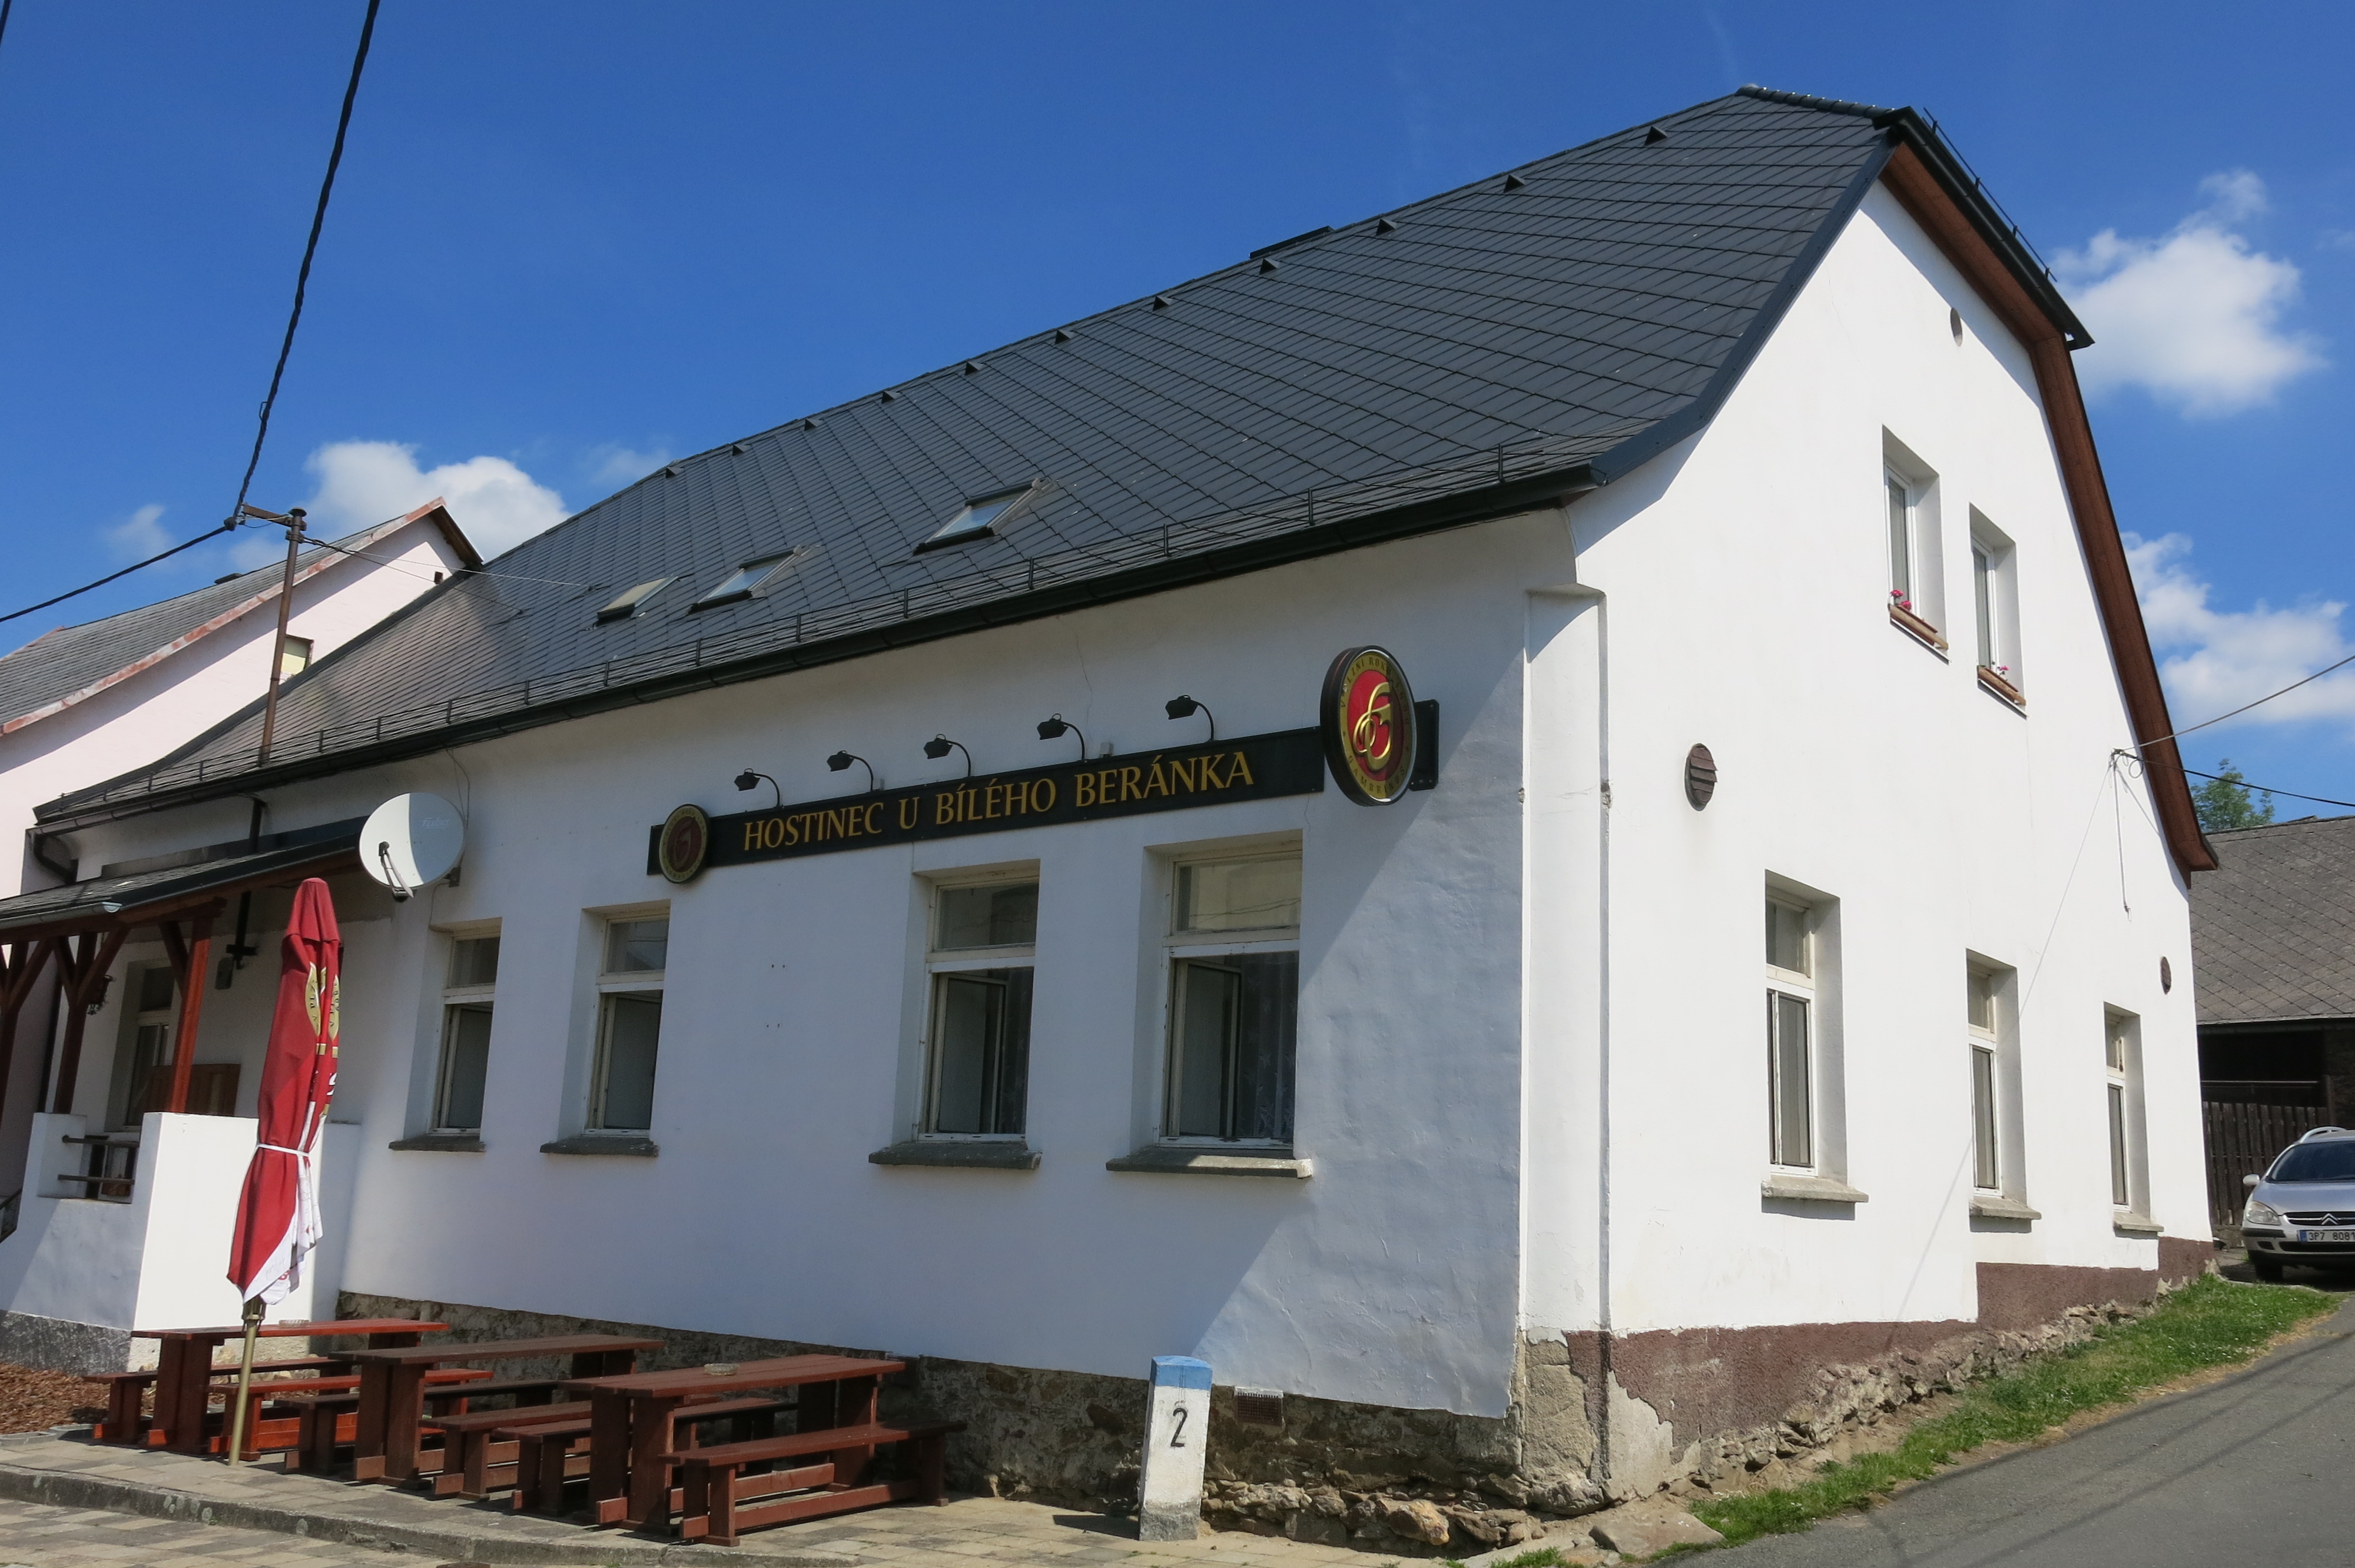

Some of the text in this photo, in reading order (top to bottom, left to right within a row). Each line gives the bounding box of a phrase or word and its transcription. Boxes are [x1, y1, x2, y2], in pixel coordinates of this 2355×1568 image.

[744, 802, 884, 851] HOSTINEC
[898, 796, 920, 830] U
[936, 778, 1057, 825] BÍLÉHO
[1074, 751, 1254, 807] BERÁNKA
[2308, 1231, 2325, 1241] 3P7
[1170, 1407, 1188, 1447] 2
